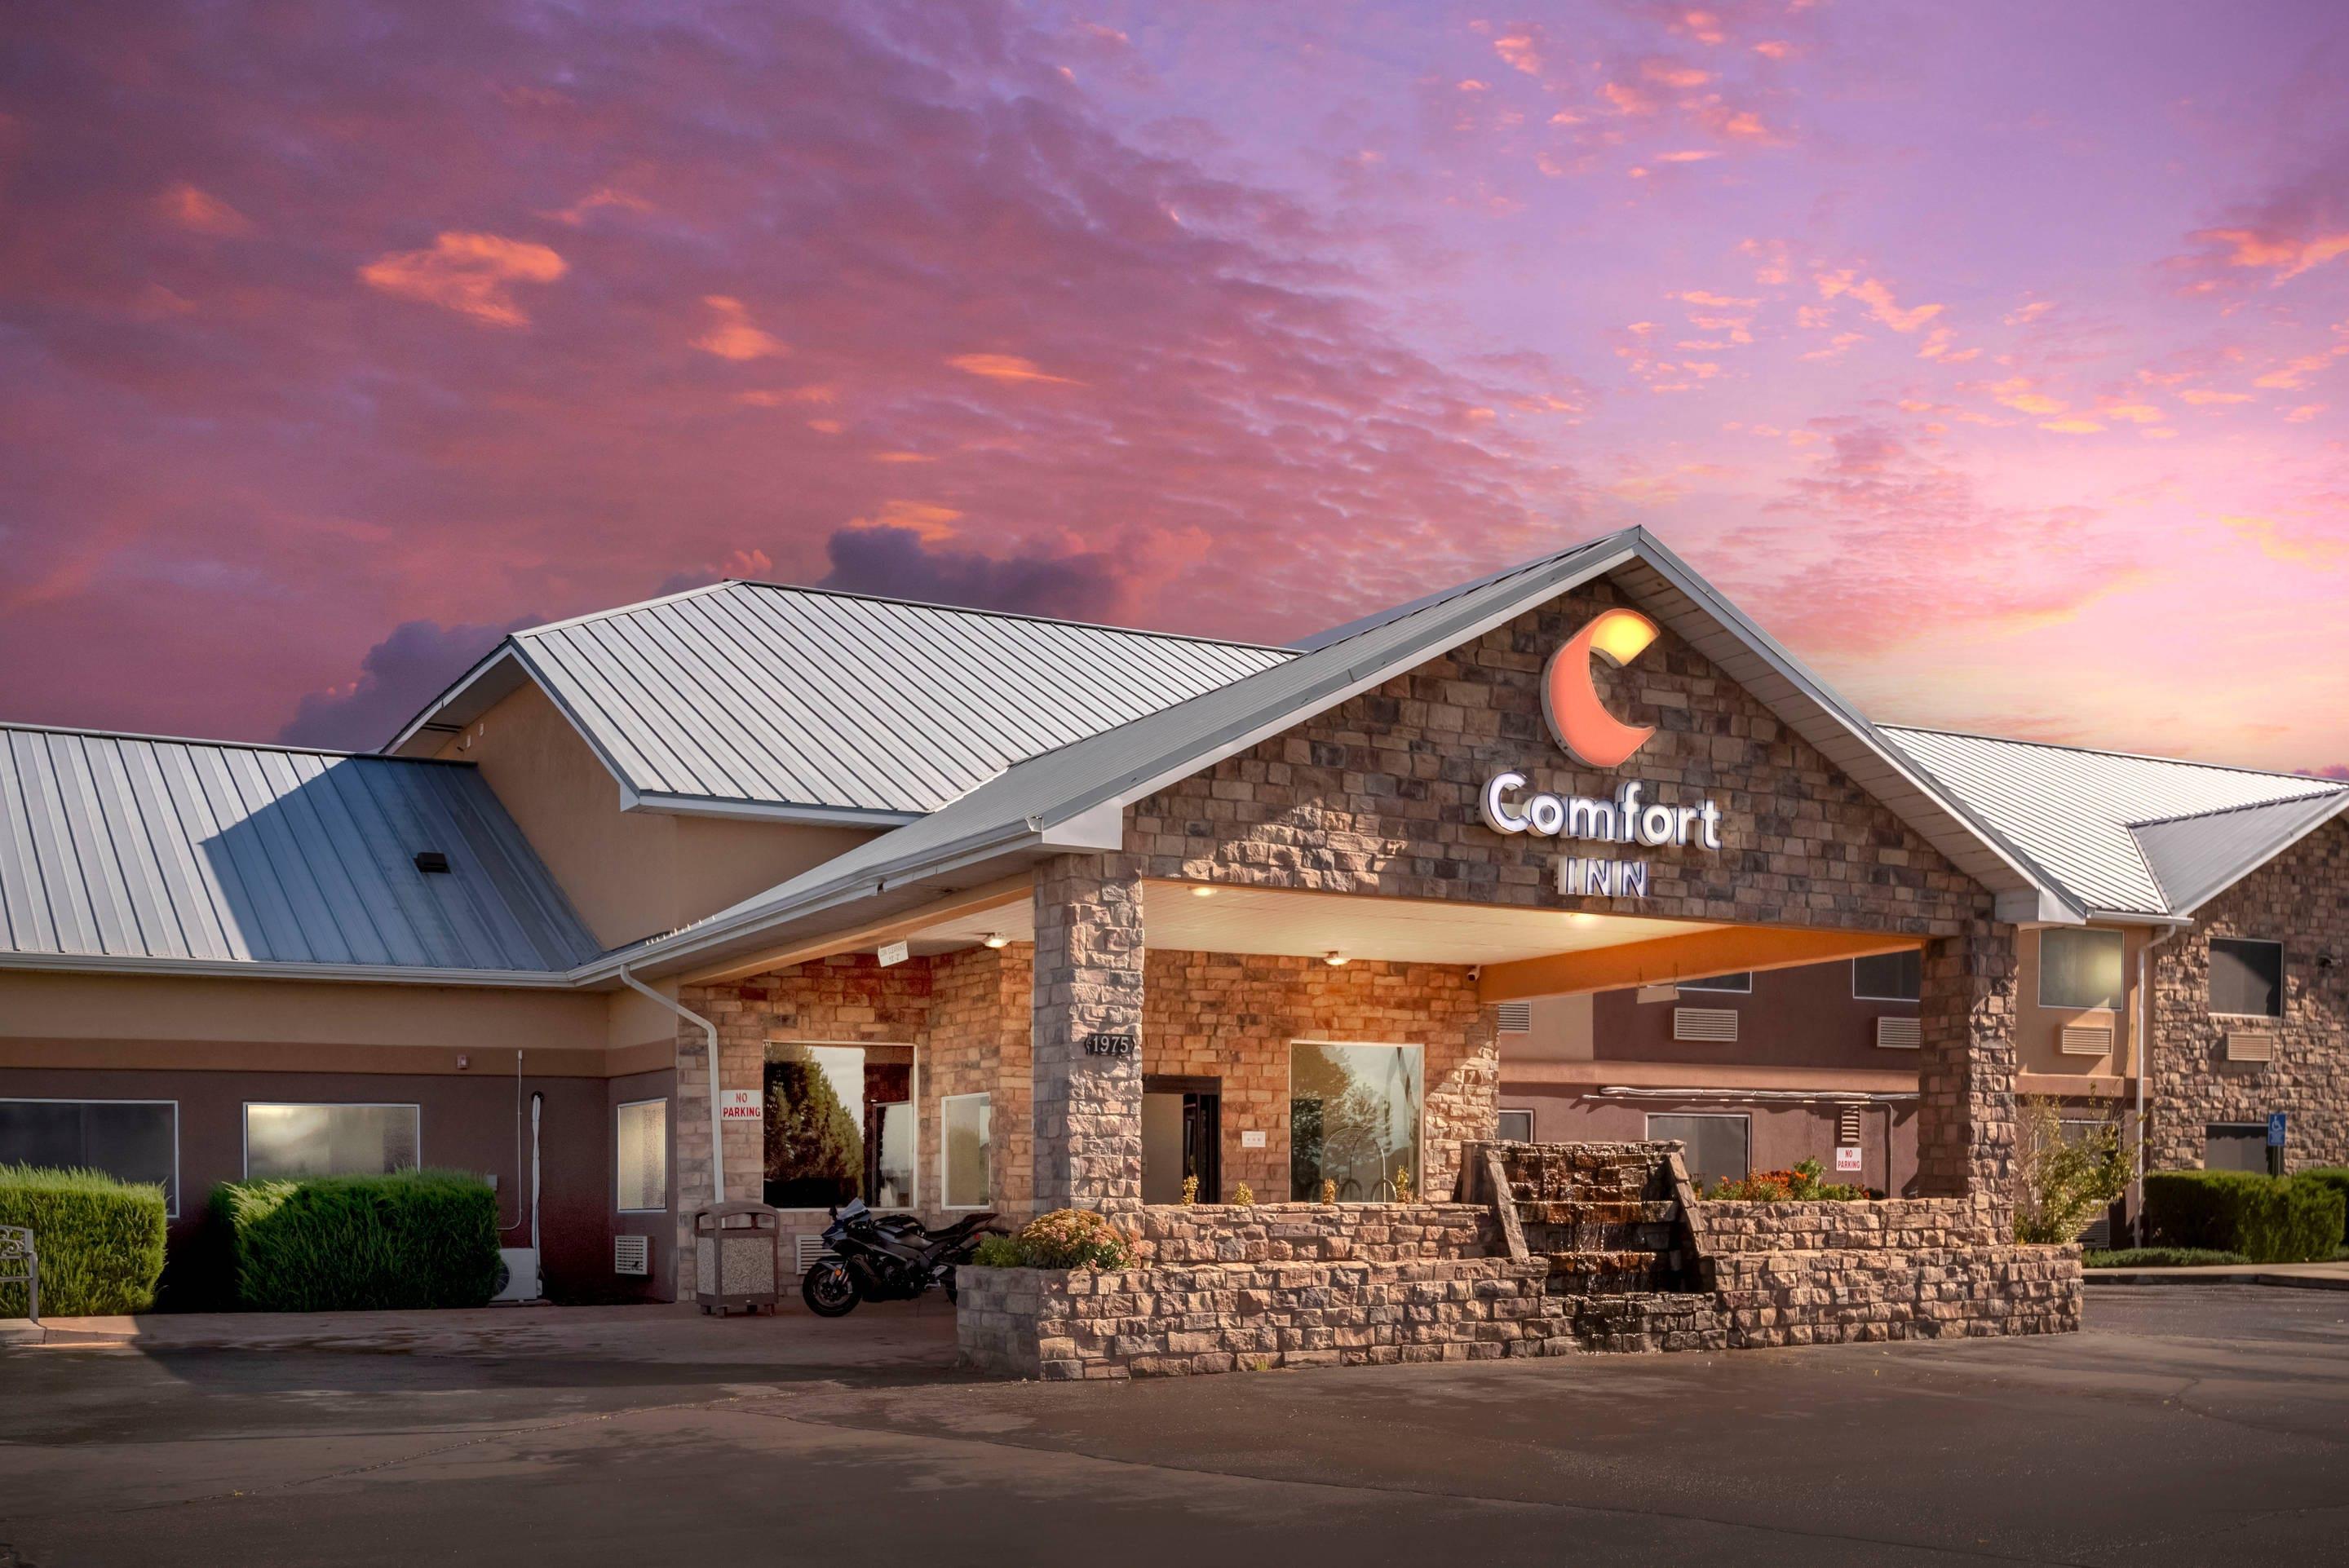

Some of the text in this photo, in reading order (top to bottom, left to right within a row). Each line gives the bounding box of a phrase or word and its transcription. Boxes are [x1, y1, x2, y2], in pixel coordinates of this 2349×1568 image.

[1480, 771, 1723, 850] Comfort
[1559, 857, 1648, 897] INN
[1093, 1036, 1129, 1053] 1975
[736, 1093, 748, 1103] NO
[723, 1106, 761, 1117] PARKING
[1845, 1150, 1853, 1158] NO
[1838, 1160, 1860, 1168] PARKING
